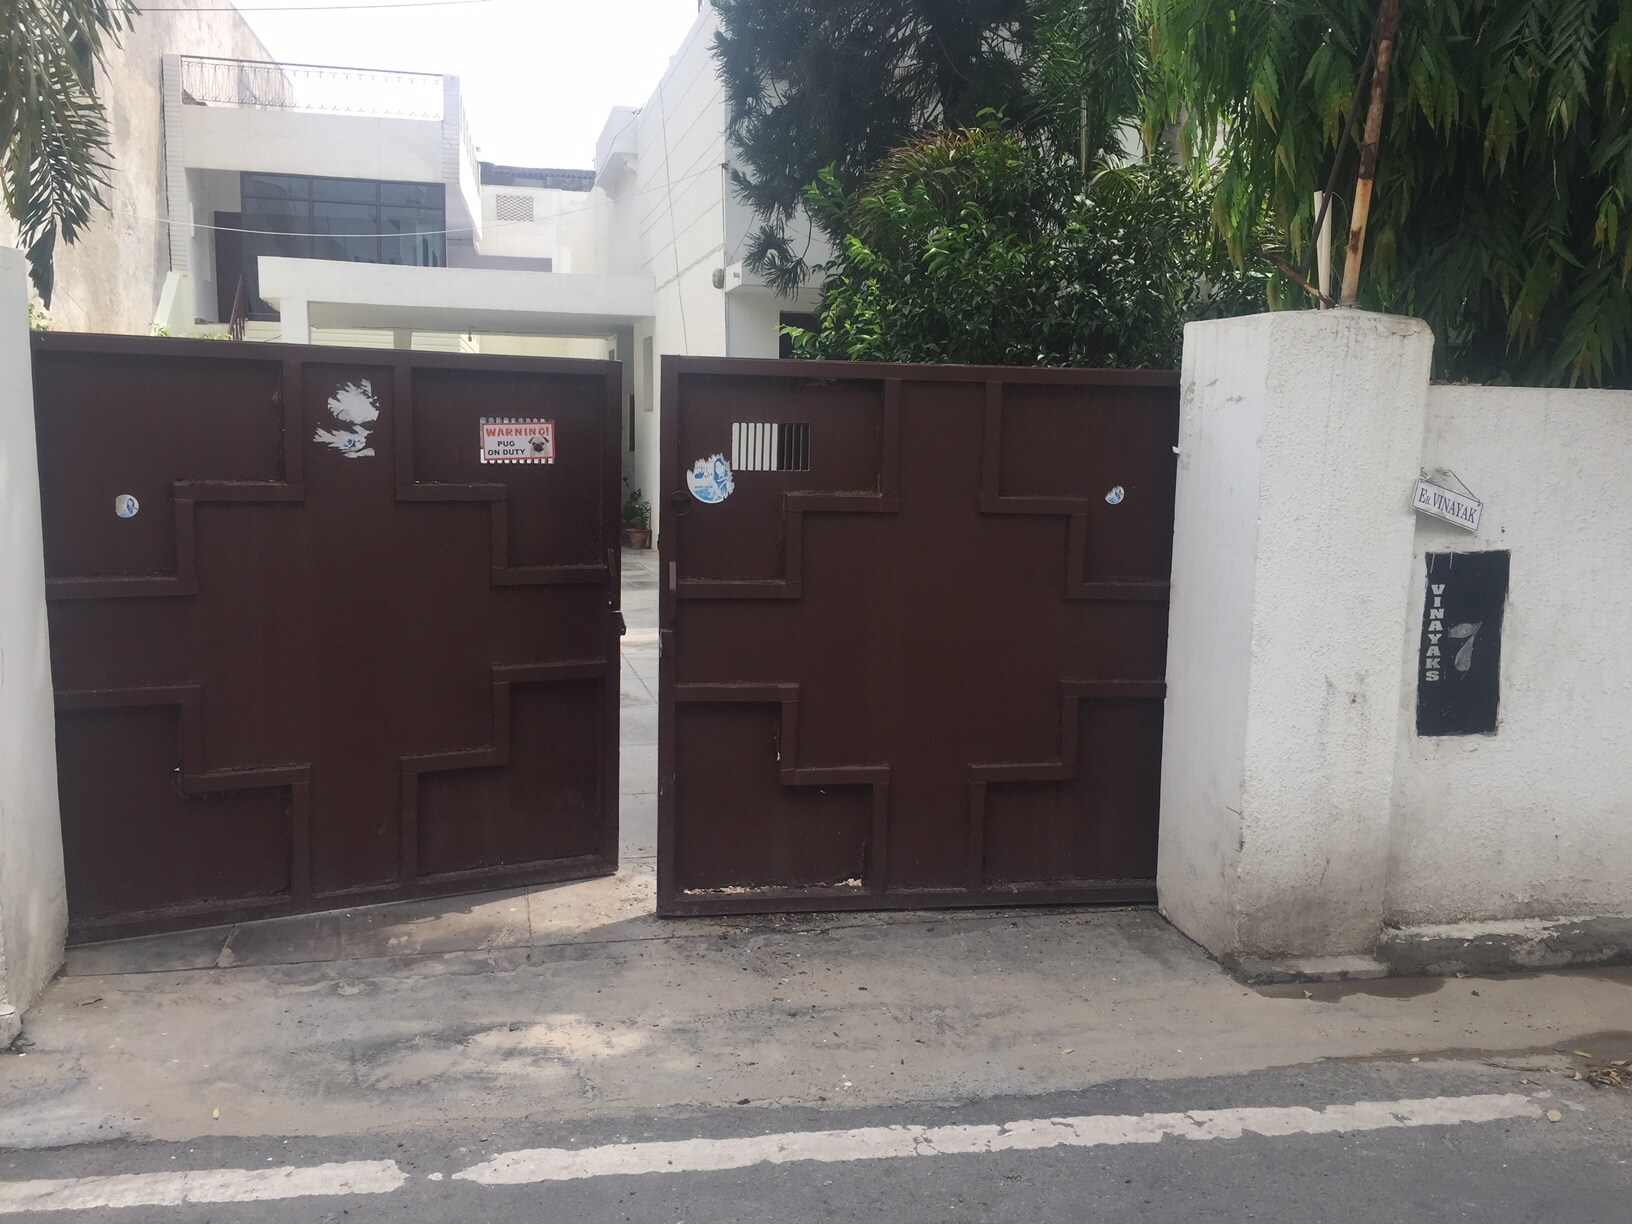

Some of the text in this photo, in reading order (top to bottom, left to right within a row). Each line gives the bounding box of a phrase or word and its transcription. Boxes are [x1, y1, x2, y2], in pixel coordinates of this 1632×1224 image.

[486, 427, 549, 437] WARNING!
[1433, 492, 1477, 523] VINAYAK
[1425, 584, 1445, 682] VINAYAKS
[1448, 621, 1482, 675] 7
